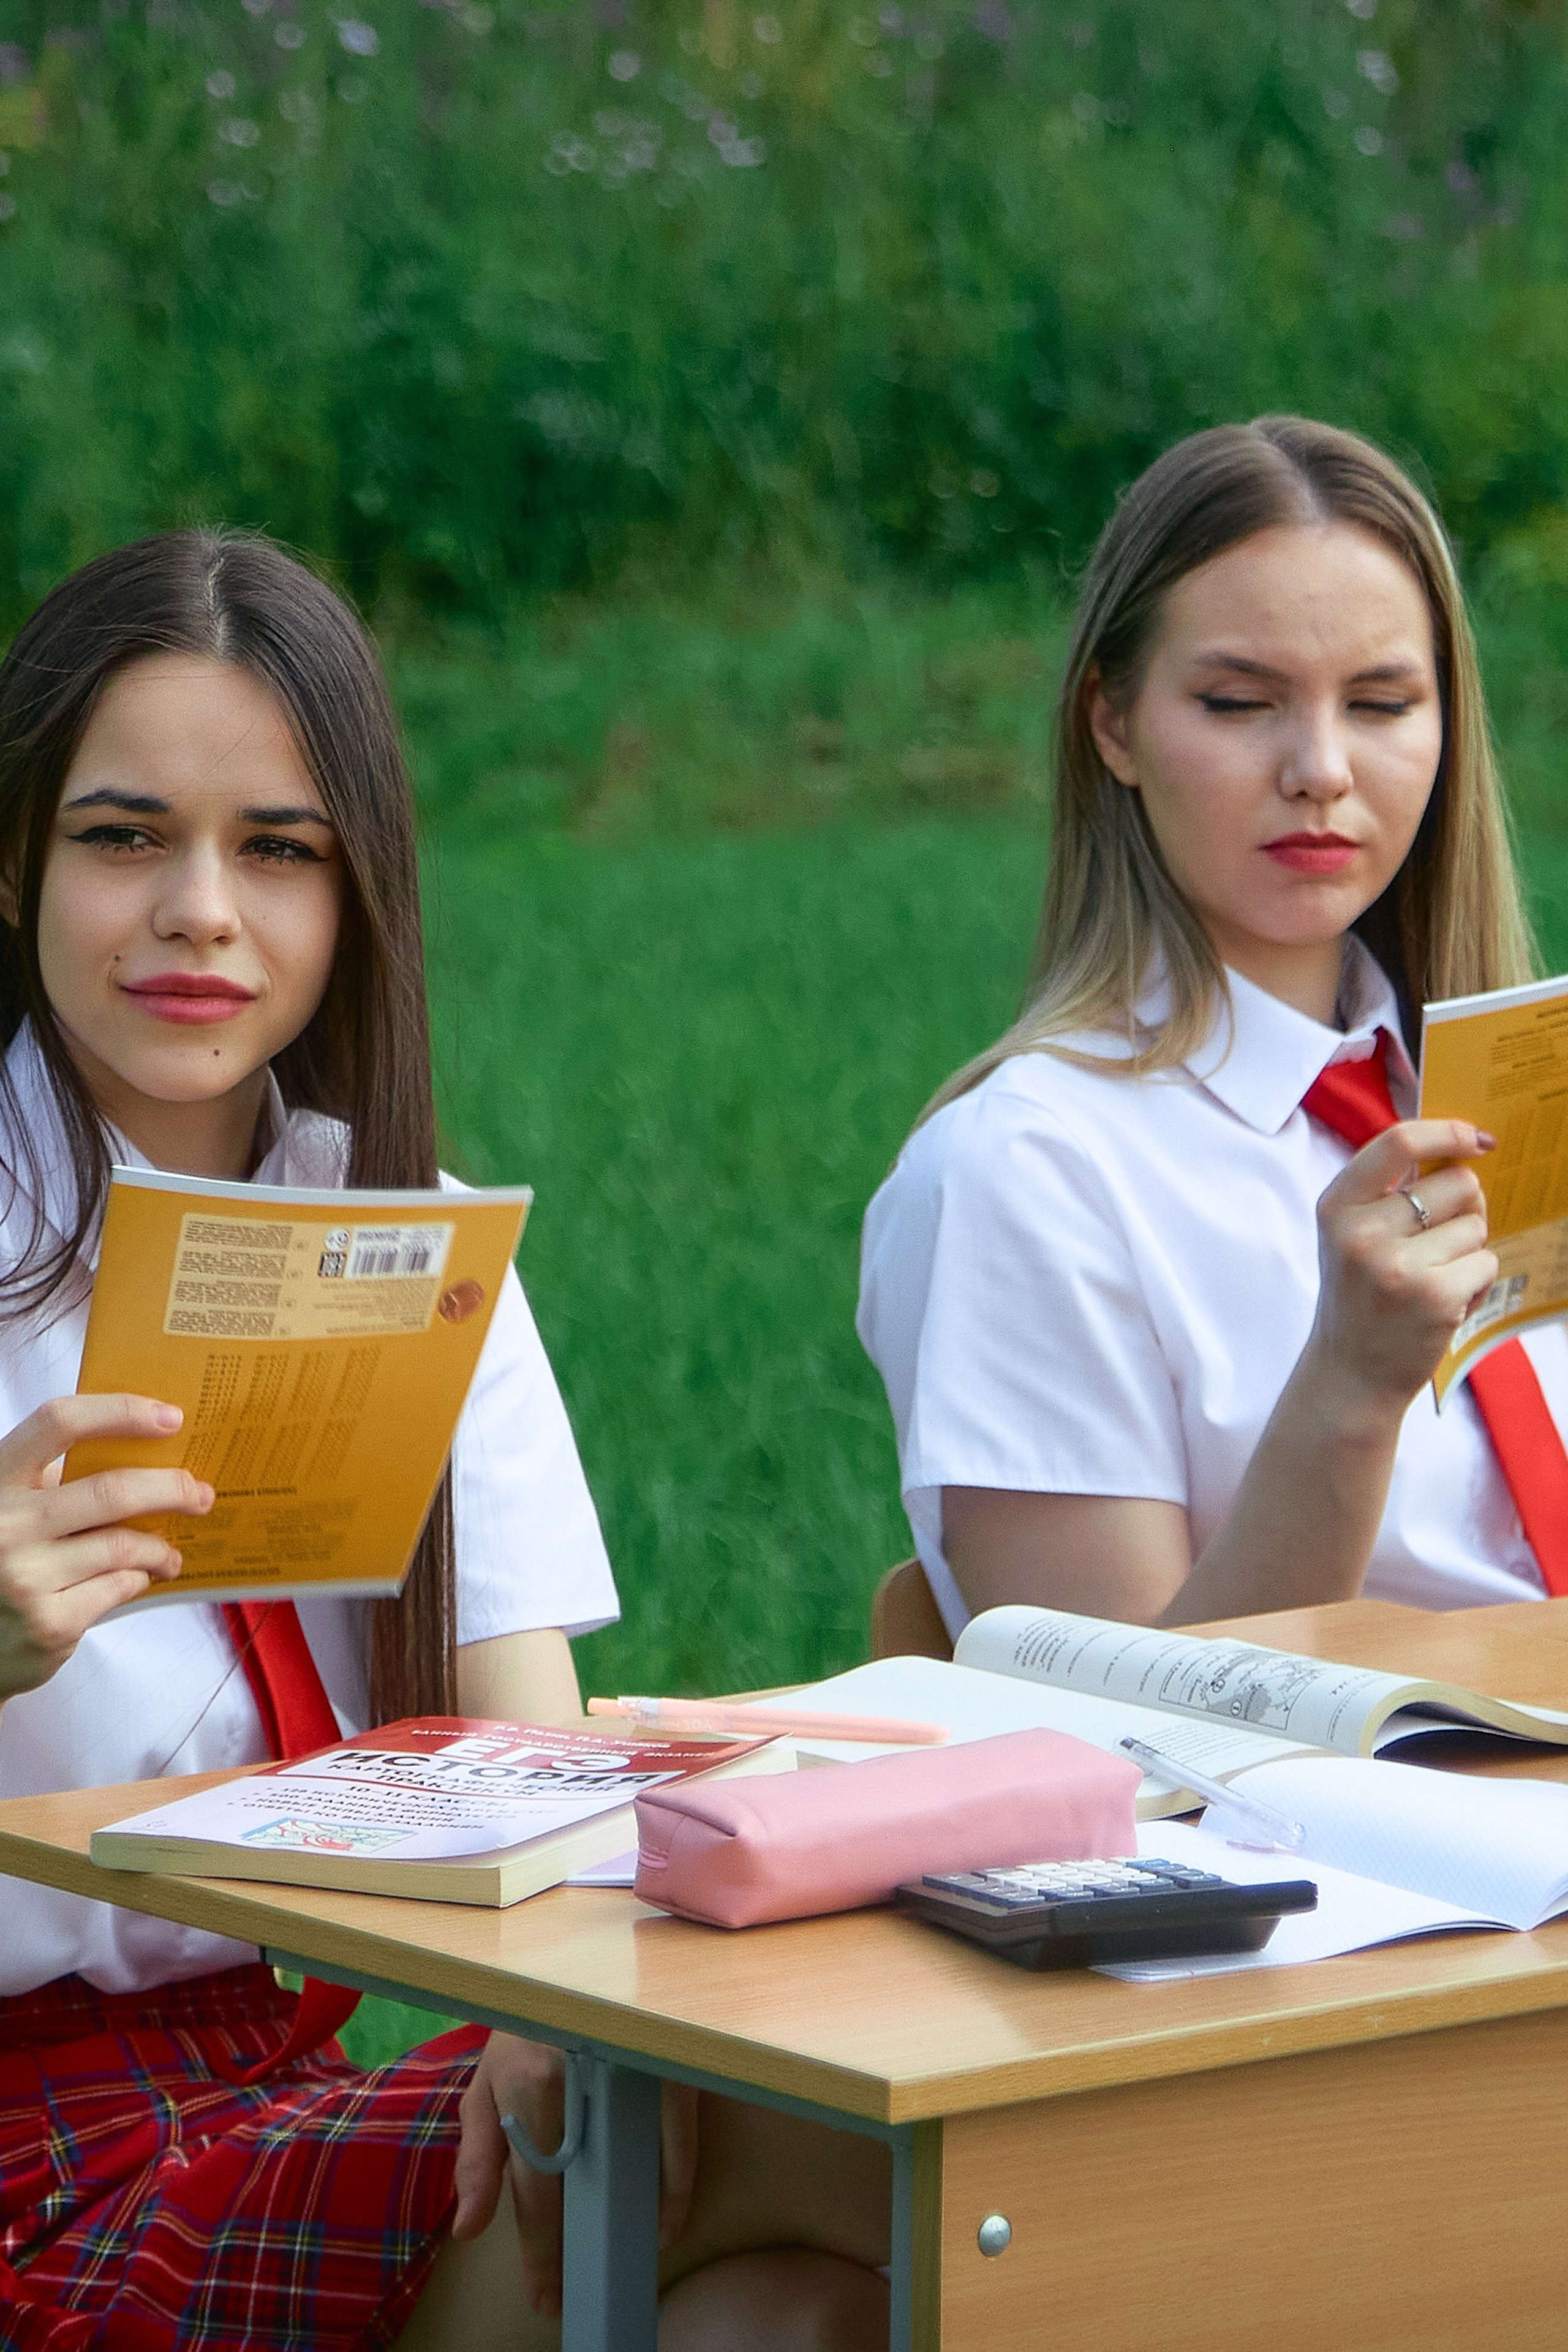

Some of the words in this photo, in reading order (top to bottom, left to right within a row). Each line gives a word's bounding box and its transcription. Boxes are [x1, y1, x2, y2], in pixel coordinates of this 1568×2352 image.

[330, 1752, 662, 1785] ИСТОРИЯ
[434, 1738, 631, 1772] ЕГЭ
[327, 1763, 616, 1792] КАРТОГРАФИЧЕСКИЙ
[375, 1775, 537, 1796] ПРАКТИКУМ
